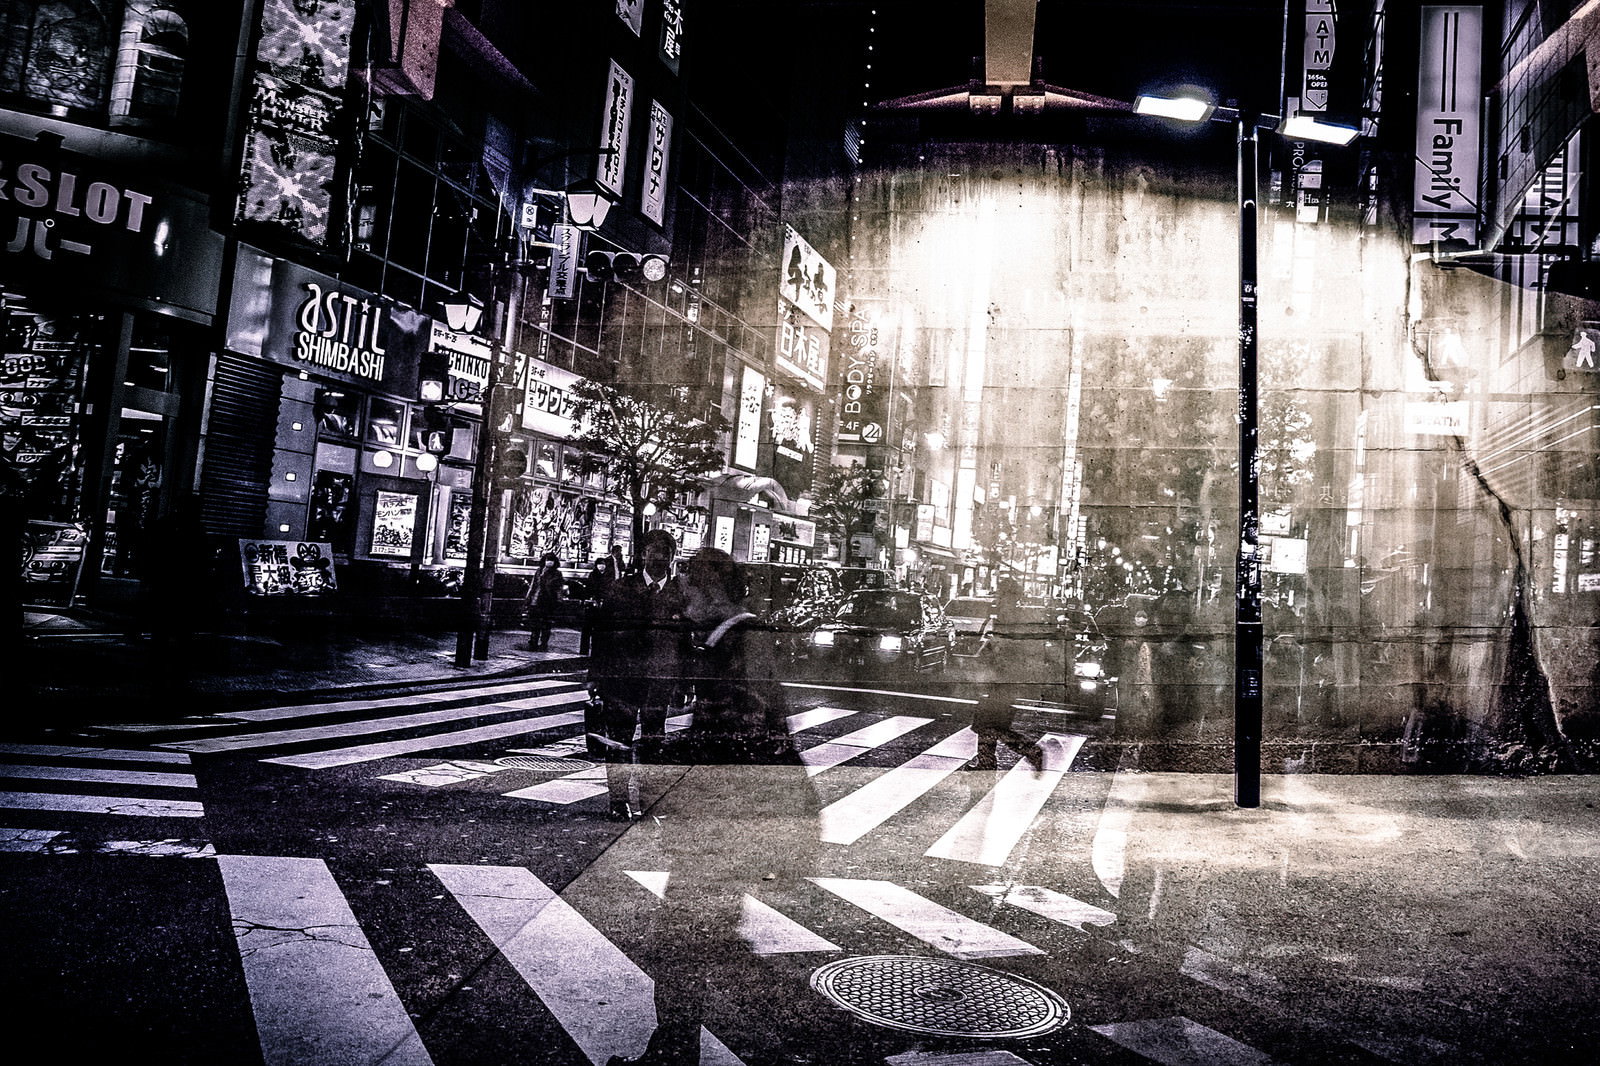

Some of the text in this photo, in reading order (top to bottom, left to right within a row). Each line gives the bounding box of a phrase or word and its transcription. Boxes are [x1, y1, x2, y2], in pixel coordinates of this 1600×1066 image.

[1314, 20, 1330, 63] ATM
[253, 86, 330, 123] MONSTER
[260, 102, 324, 132] HUNTER
[650, 122, 665, 196] サウナ
[1422, 118, 1463, 210] Family
[297, 331, 385, 381] SHIMBASHI
[845, 308, 869, 413] BODY SPA
[536, 383, 576, 415] サウナ
[258, 544, 288, 564] 新橋
